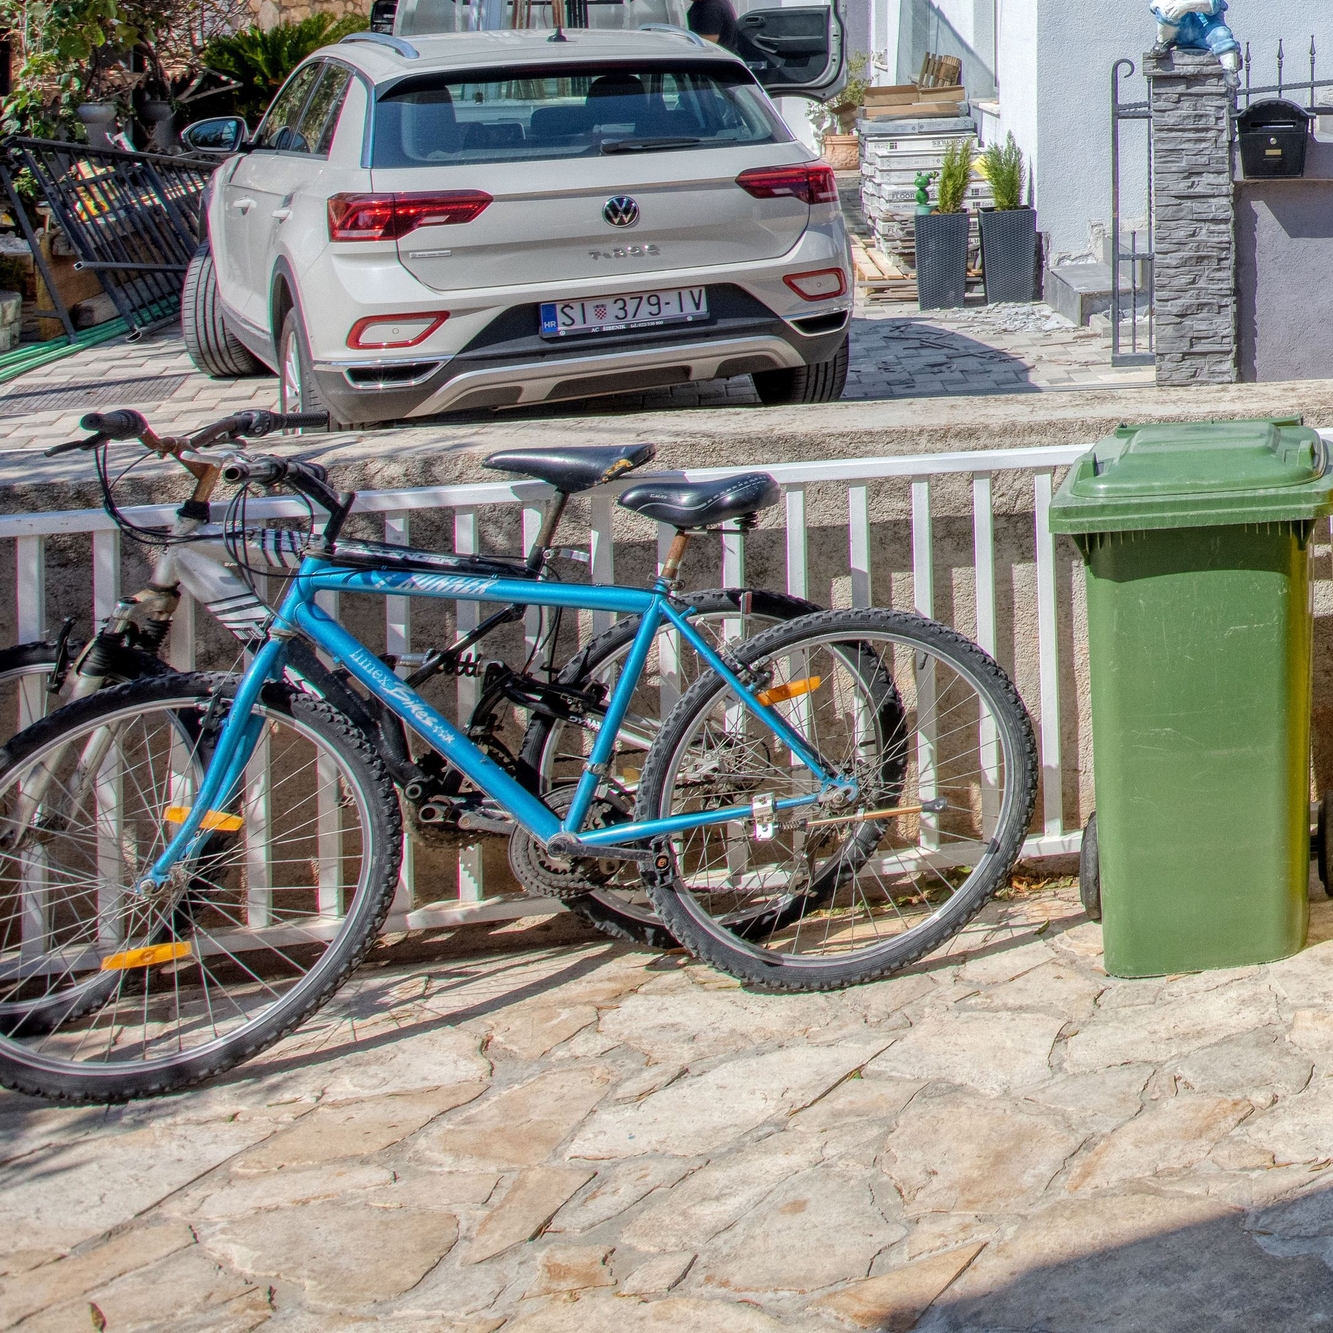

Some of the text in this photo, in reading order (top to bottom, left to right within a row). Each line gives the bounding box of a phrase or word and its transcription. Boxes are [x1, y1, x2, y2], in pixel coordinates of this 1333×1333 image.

[560, 288, 703, 327] ŠI 379-IV
[543, 321, 557, 329] HR
